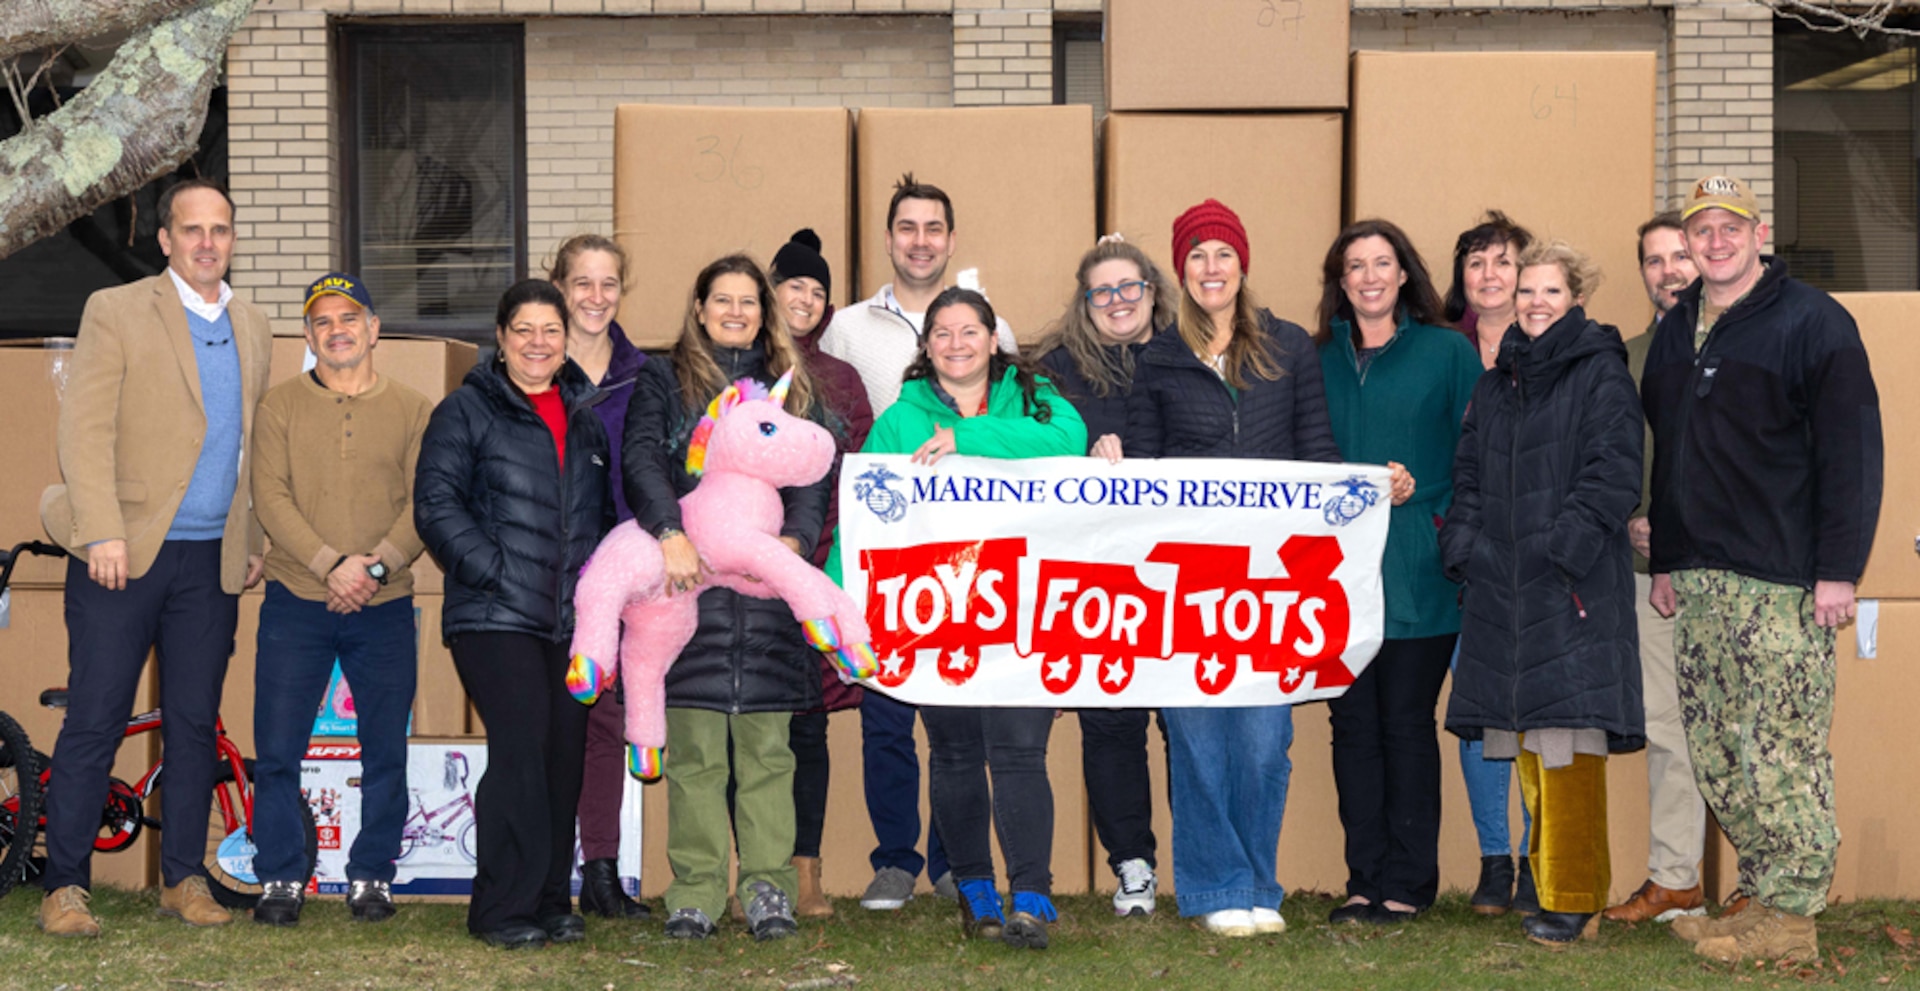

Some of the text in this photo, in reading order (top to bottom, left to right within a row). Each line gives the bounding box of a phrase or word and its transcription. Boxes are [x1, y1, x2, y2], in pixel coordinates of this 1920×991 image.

[1529, 82, 1580, 128] 64
[694, 134, 765, 191] 36
[311, 277, 355, 293] NAVY
[911, 475, 1323, 510] MARINE CORPS RESERVE
[876, 560, 1327, 657] TOYS FOR TOTS
[319, 884, 340, 894] SEA
